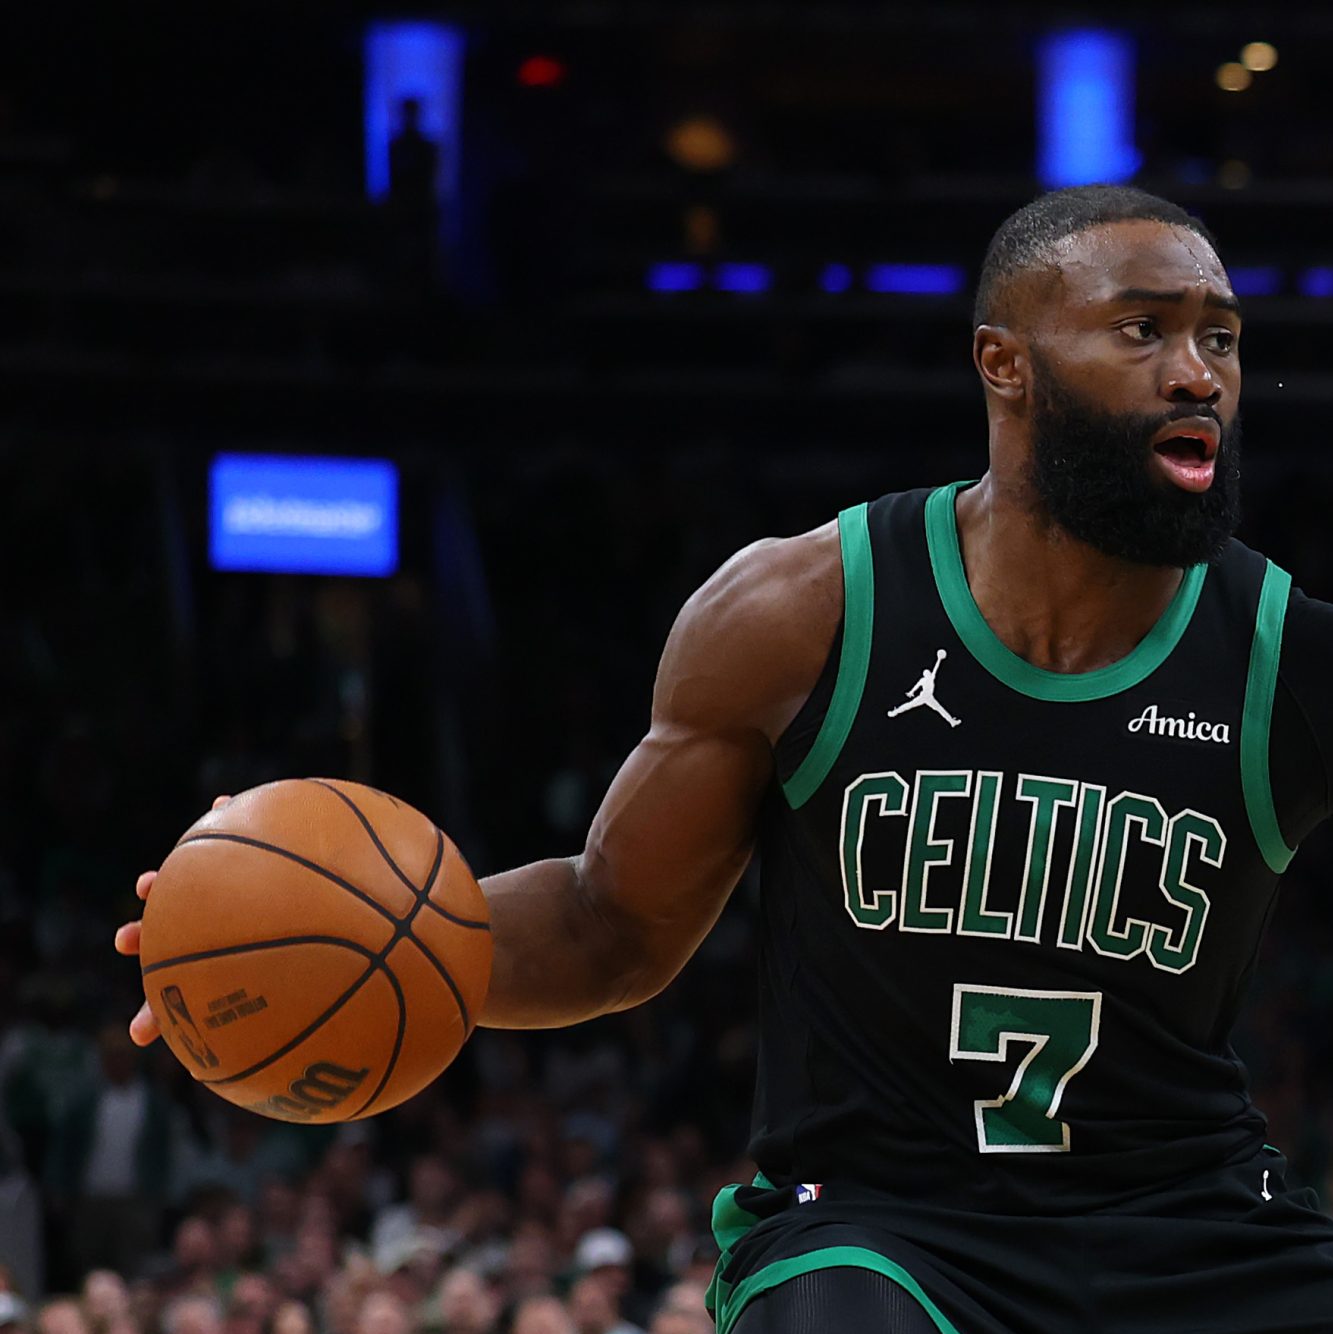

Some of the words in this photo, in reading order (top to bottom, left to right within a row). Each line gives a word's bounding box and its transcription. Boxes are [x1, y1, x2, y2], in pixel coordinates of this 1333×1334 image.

[1128, 705, 1230, 744] Amica
[840, 769, 1227, 974] CELTICS
[950, 983, 1102, 1153] 7
